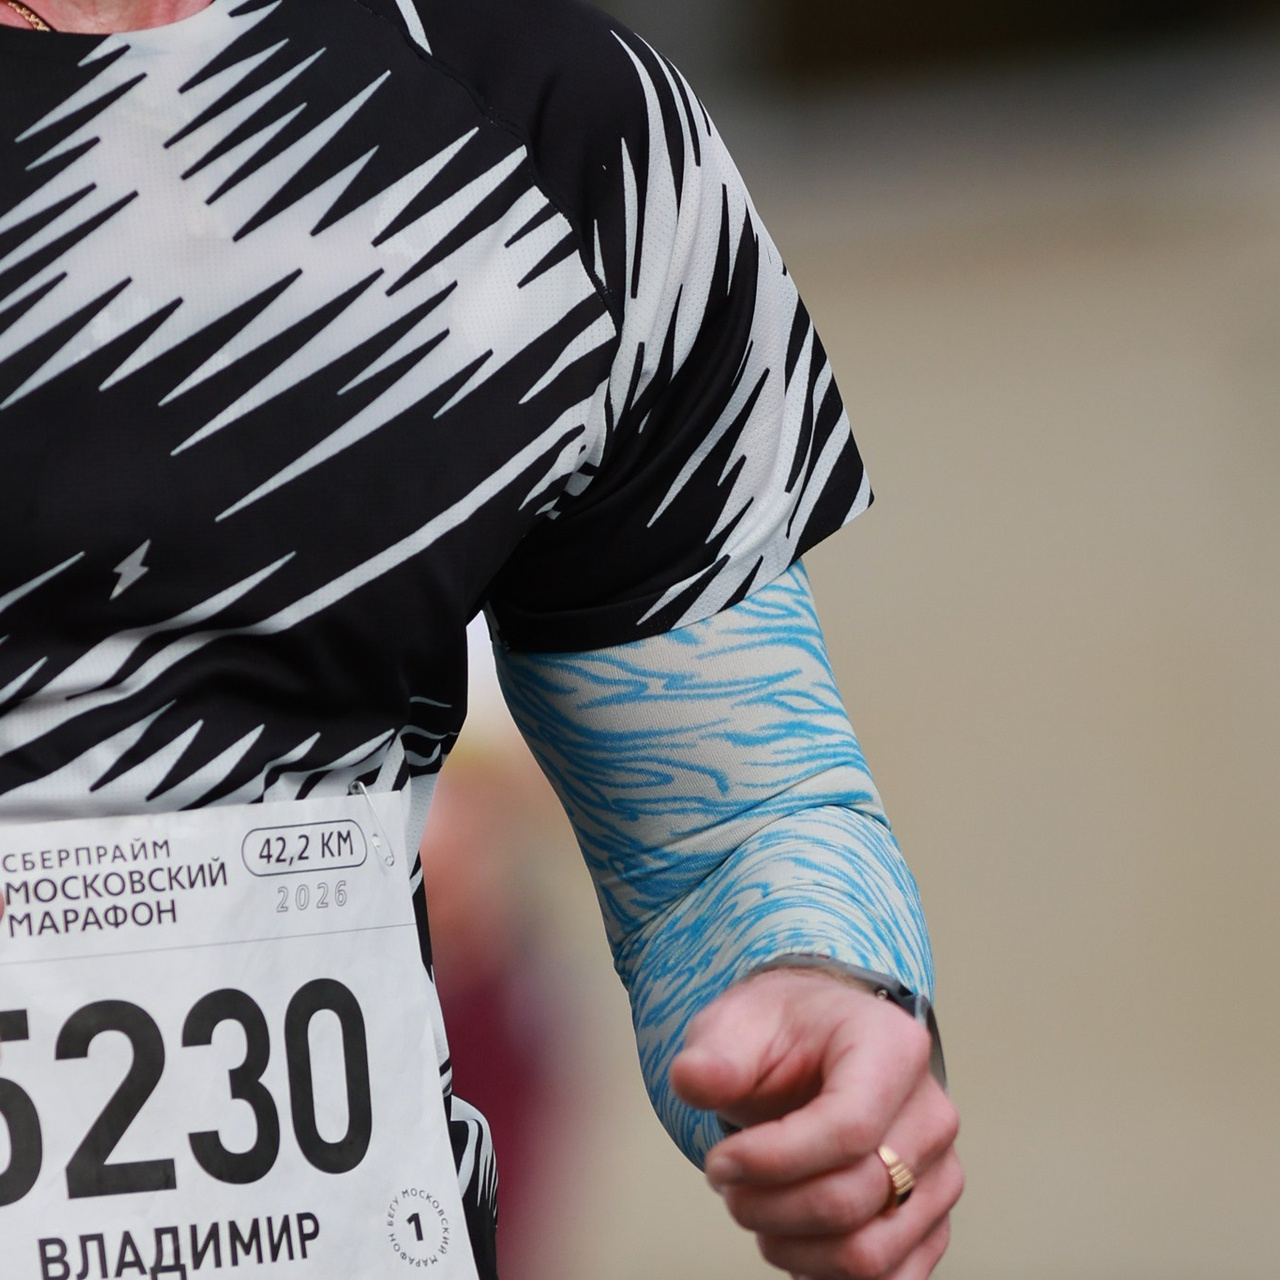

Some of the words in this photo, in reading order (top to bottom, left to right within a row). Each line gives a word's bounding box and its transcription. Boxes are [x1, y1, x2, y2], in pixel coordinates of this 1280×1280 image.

[2, 839, 171, 873] СБЕРПРАЙМ
[259, 835, 310, 866] 42,2
[321, 830, 354, 859] КМ
[4, 857, 228, 905] МОСКОВСКИЙ
[276, 880, 348, 913] 2026
[8, 899, 177, 938] МАРАФОН
[401, 1187, 450, 1254] МОСКОВСКИЙ
[406, 1212, 424, 1242] 1
[388, 1233, 438, 1267] МАРАФОН
